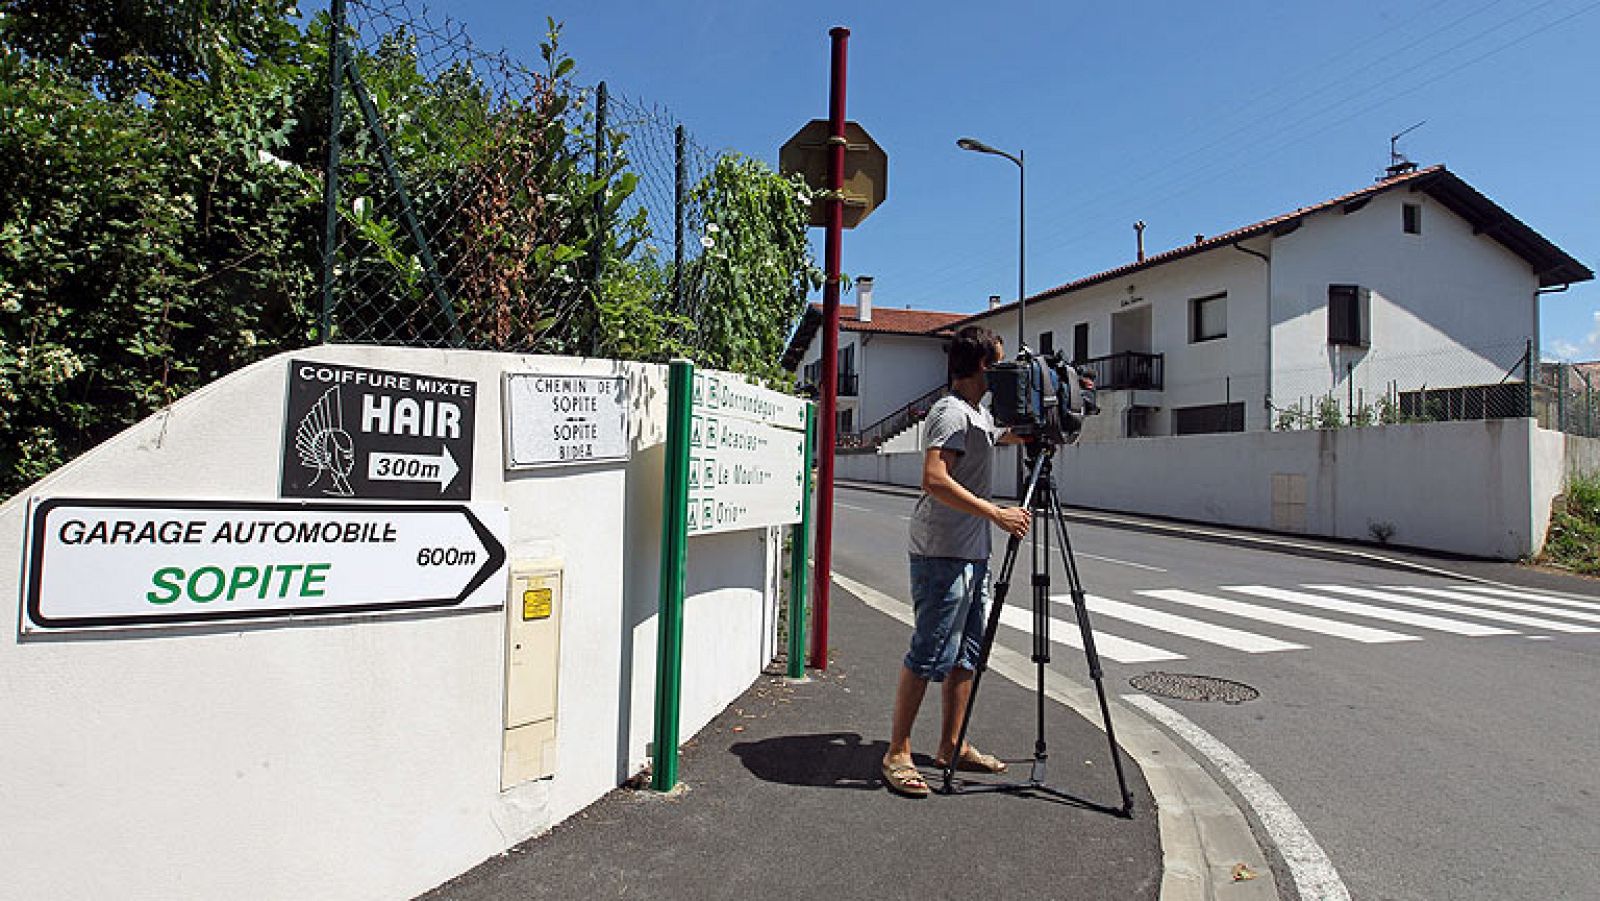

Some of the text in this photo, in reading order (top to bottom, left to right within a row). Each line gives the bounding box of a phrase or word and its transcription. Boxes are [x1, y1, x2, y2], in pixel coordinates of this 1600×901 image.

[299, 366, 472, 397] COIFFURE MIXTE
[535, 379, 611, 395] CHEMIN DE
[552, 396, 597, 413] SOPITE
[361, 393, 462, 439] HAIR
[553, 423, 597, 441] SOPITE
[376, 458, 440, 478] 300m
[718, 463, 729, 485] Le
[59, 519, 397, 545] GARAGE AUTOMOBILE
[417, 547, 476, 567] 600m
[147, 562, 332, 605] SOPITE
